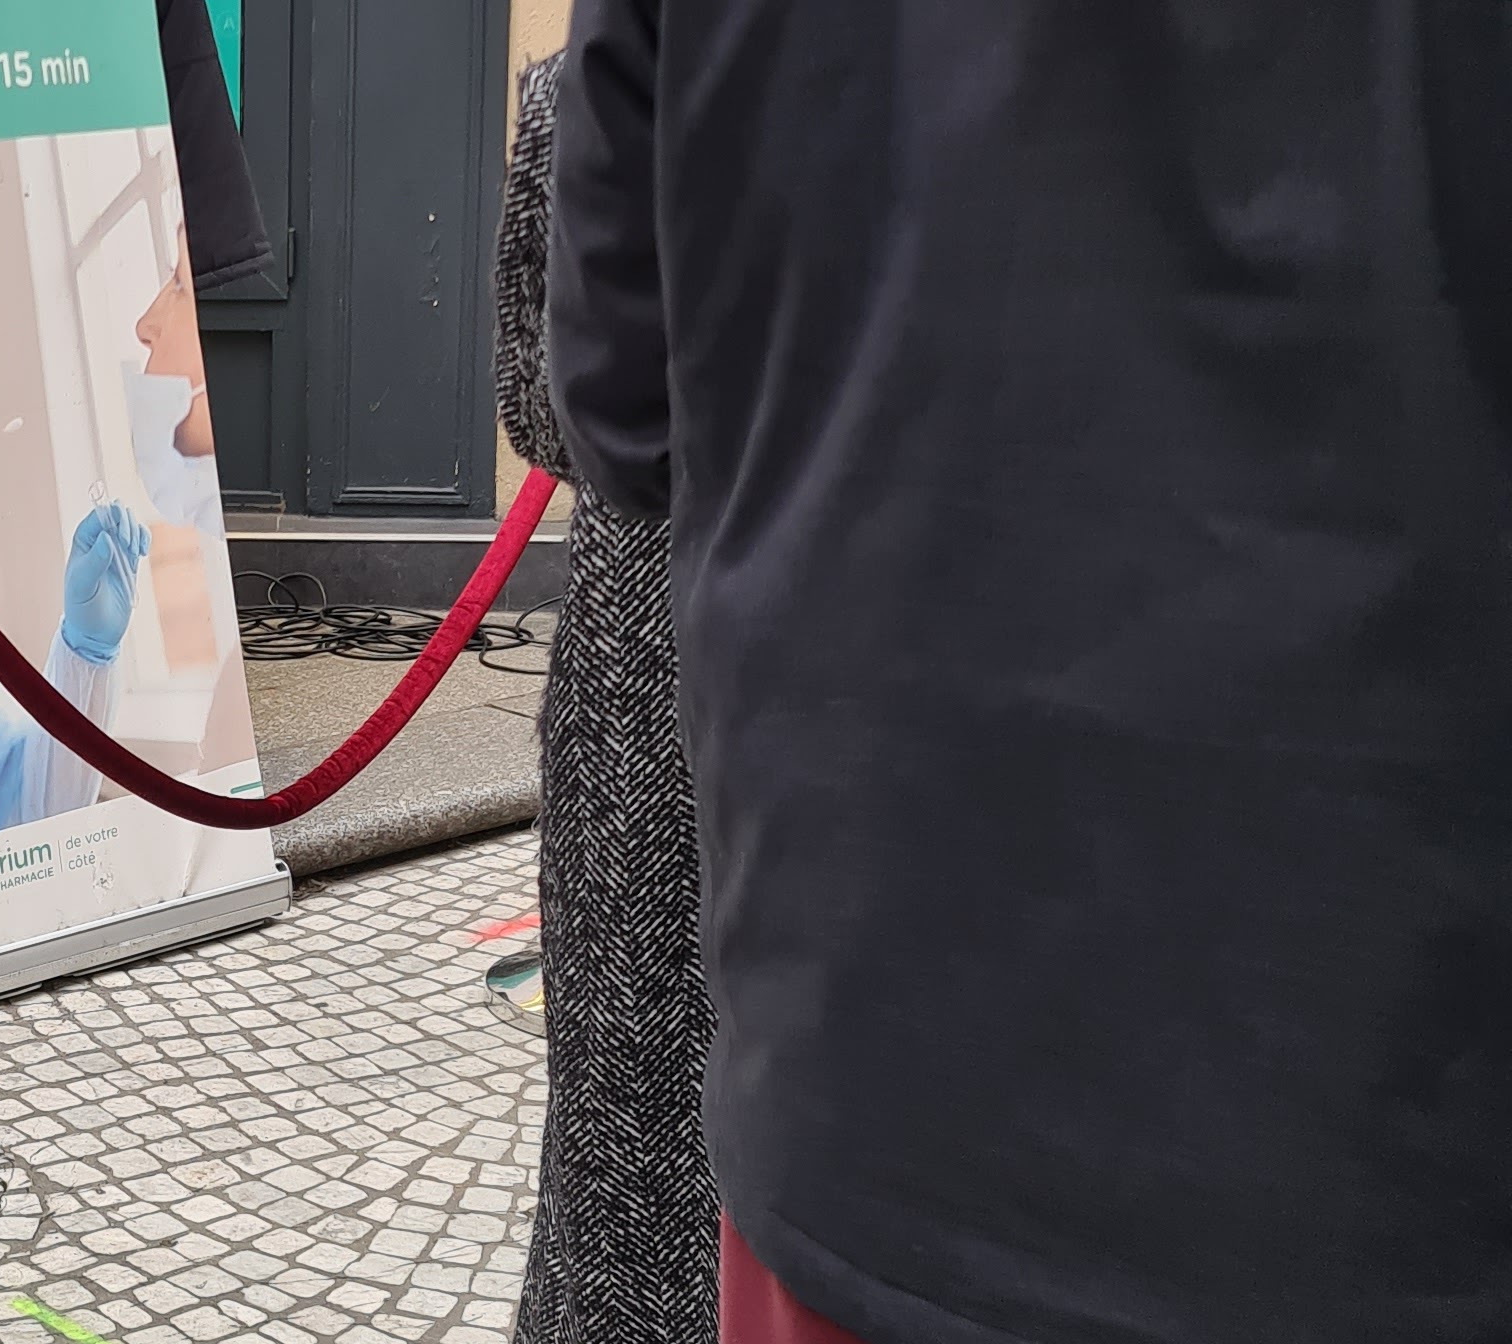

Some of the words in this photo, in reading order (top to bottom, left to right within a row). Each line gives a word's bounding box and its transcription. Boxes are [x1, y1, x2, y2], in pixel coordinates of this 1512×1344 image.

[40, 50, 89, 86] min
[65, 834, 82, 851] de
[84, 826, 119, 845] votre
[68, 851, 96, 870] côté
